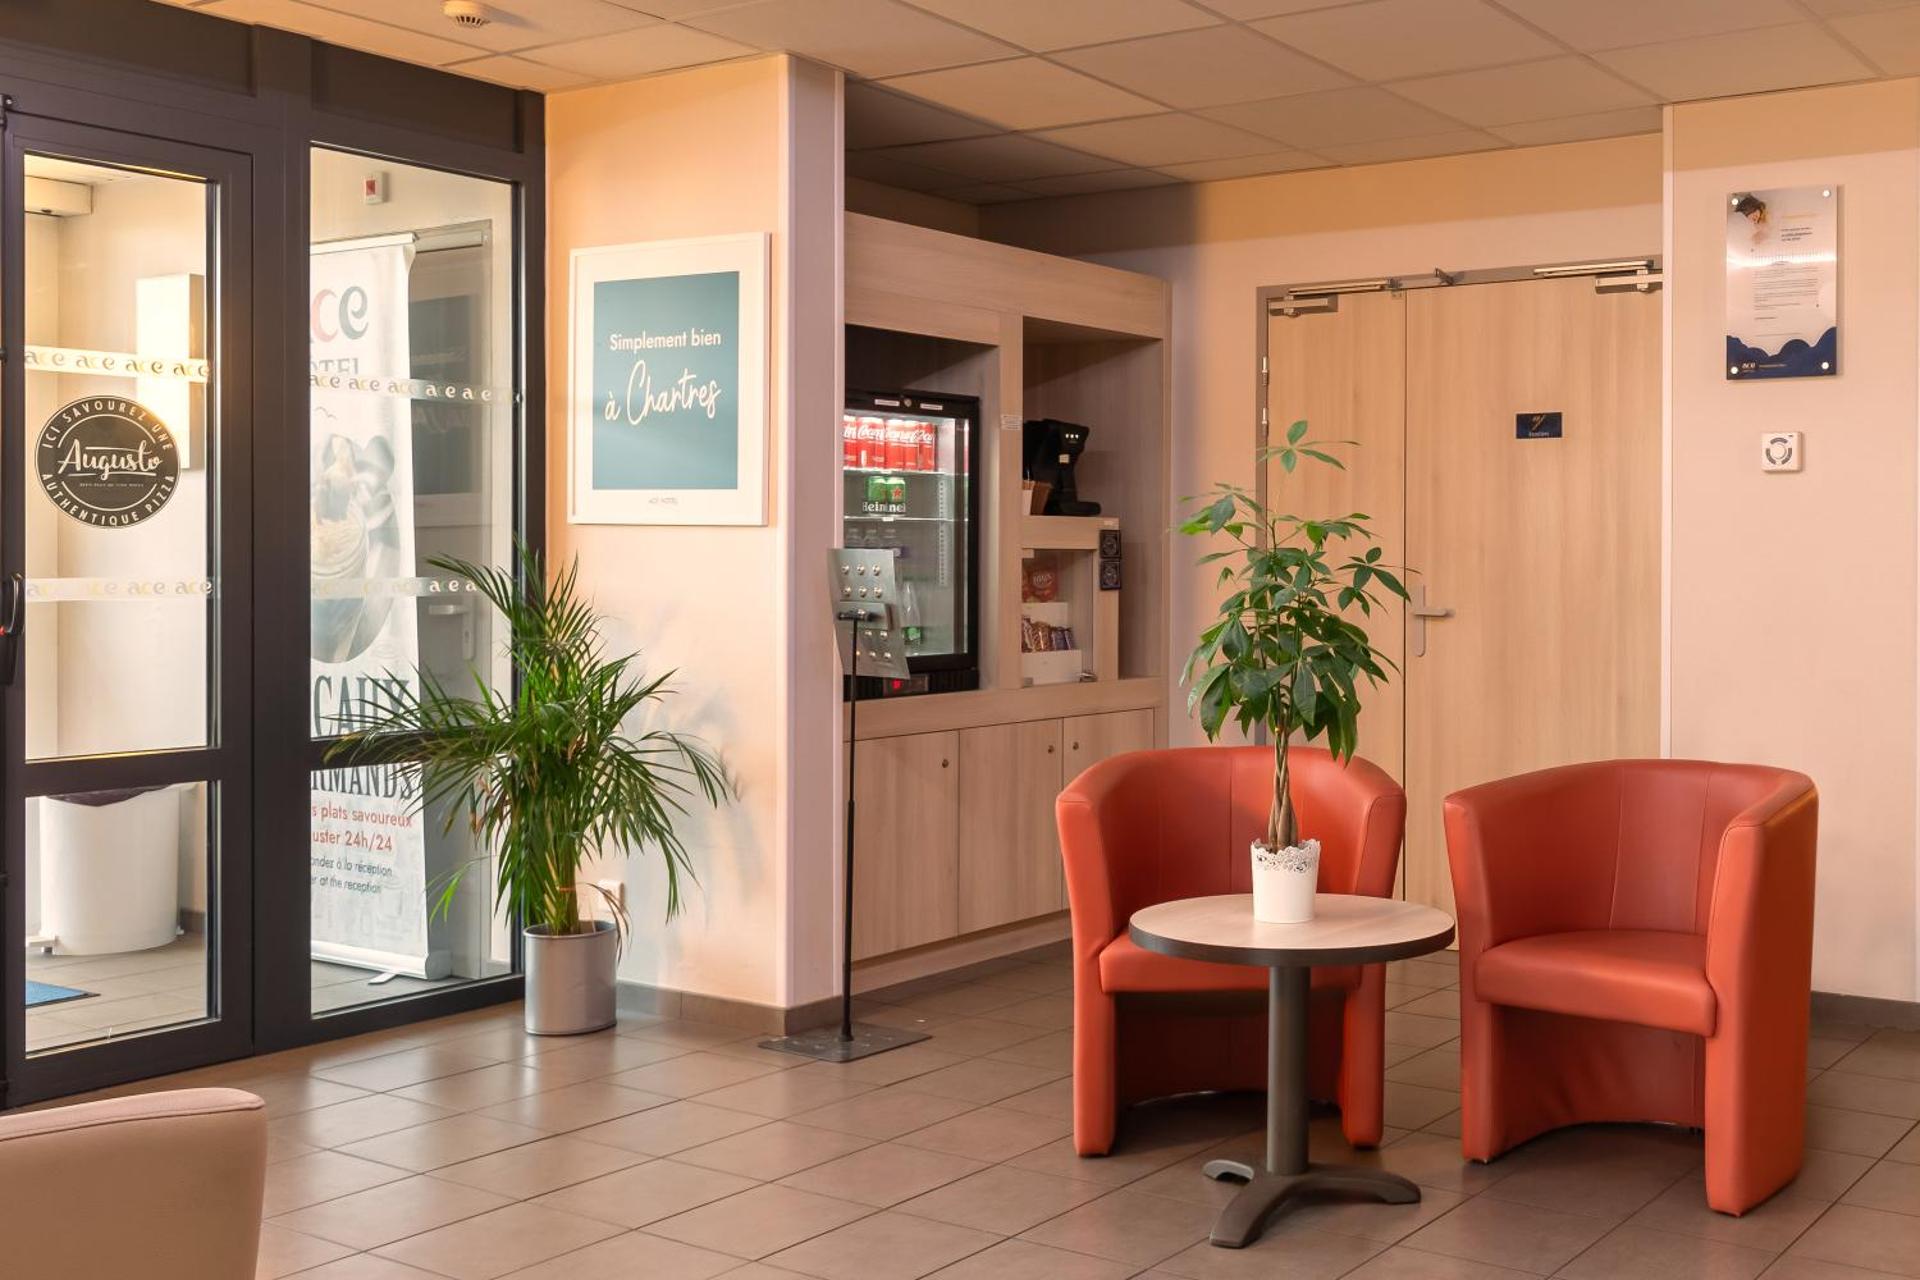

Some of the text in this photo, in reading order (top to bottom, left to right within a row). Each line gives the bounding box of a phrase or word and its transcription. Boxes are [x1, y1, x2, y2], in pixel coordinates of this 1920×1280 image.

[310, 285, 369, 344] ce
[609, 328, 722, 353] Simplement bien
[604, 359, 722, 425] à Chartres
[42, 399, 174, 452] ICI SAVOUREZ UNE
[57, 438, 163, 481] Augusto
[41, 473, 175, 528] AUTHENTIQUE PIZZA
[320, 801, 348, 821] plats
[352, 811, 413, 829] savoureux
[312, 830, 393, 853] uster 24h/24
[355, 860, 393, 878] réception
[344, 880, 382, 895] reception
